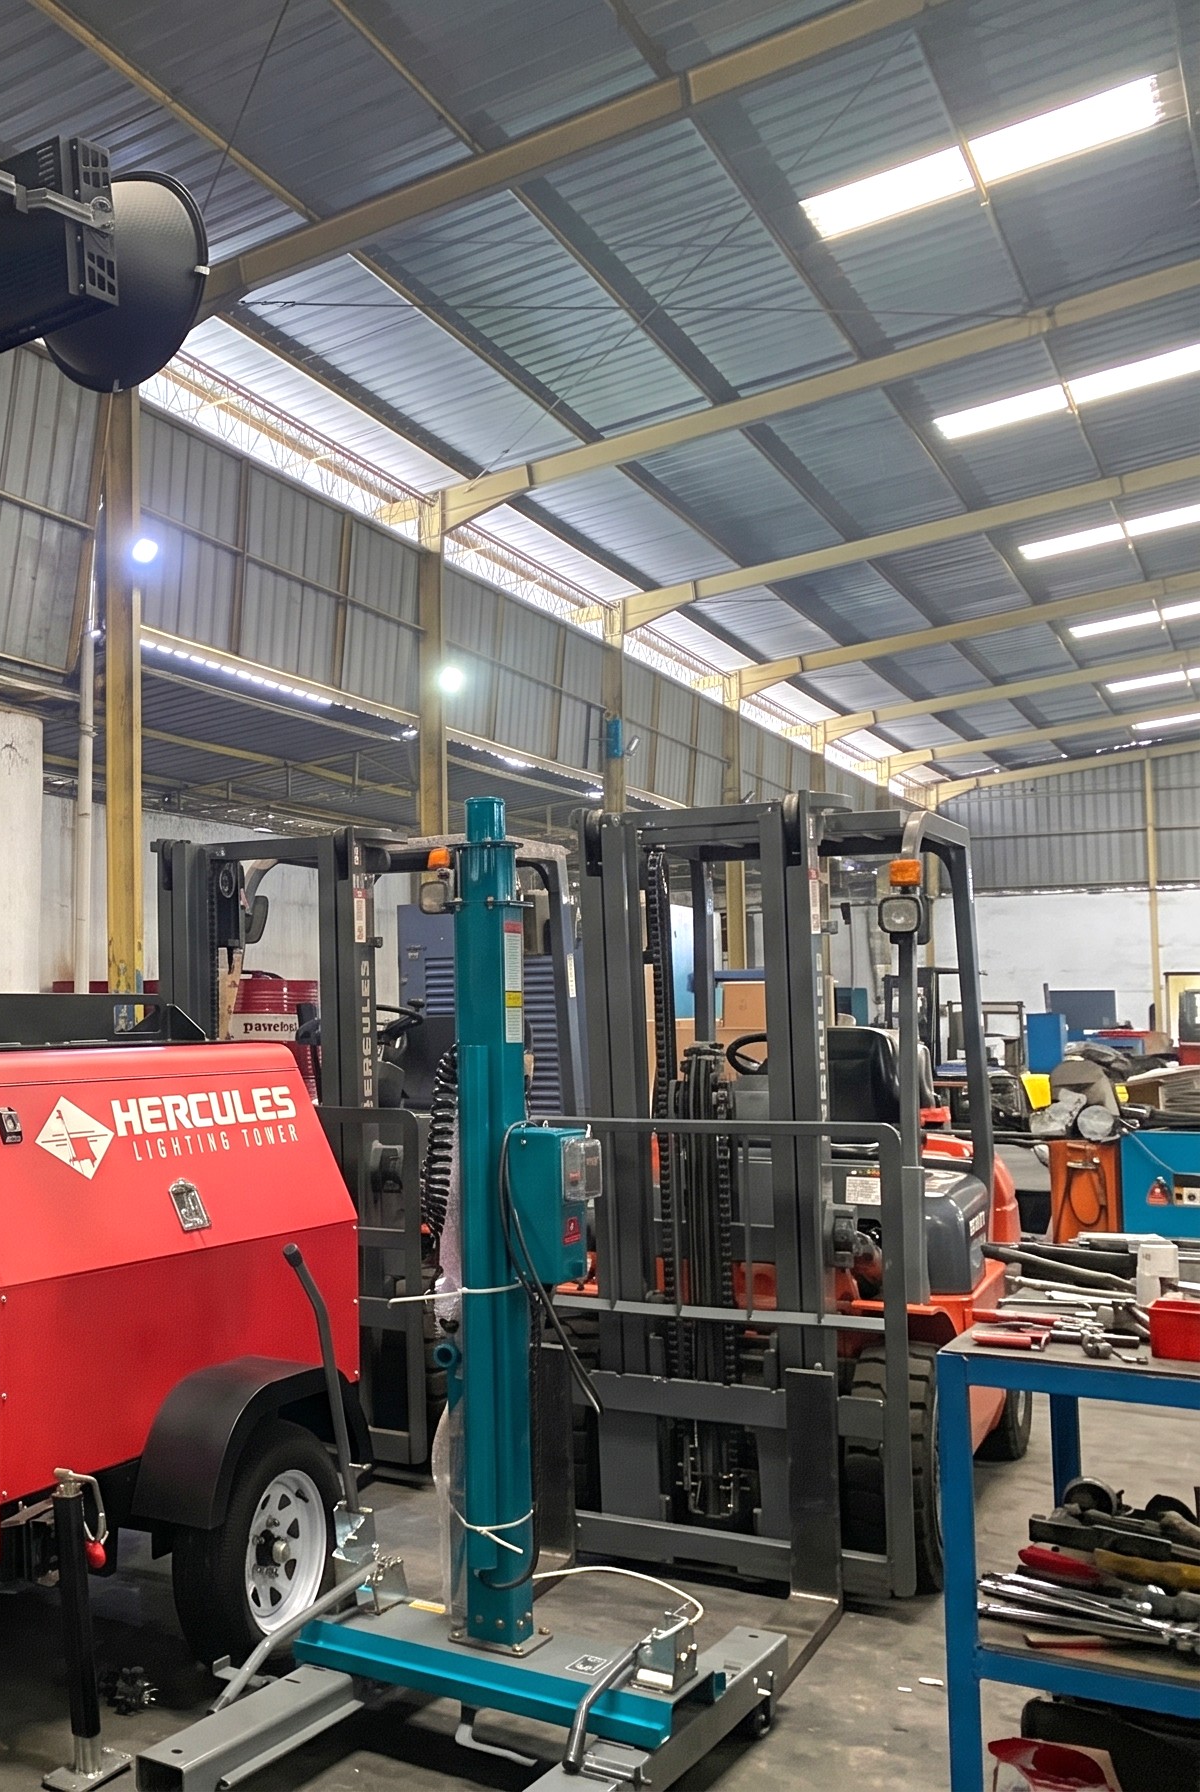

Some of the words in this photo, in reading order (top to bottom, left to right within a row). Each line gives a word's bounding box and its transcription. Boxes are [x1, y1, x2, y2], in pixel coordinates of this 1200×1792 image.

[110, 1086, 297, 1137] HERCULES
[132, 1131, 230, 1161] LIGHTING
[241, 1123, 299, 1148] TOWER
